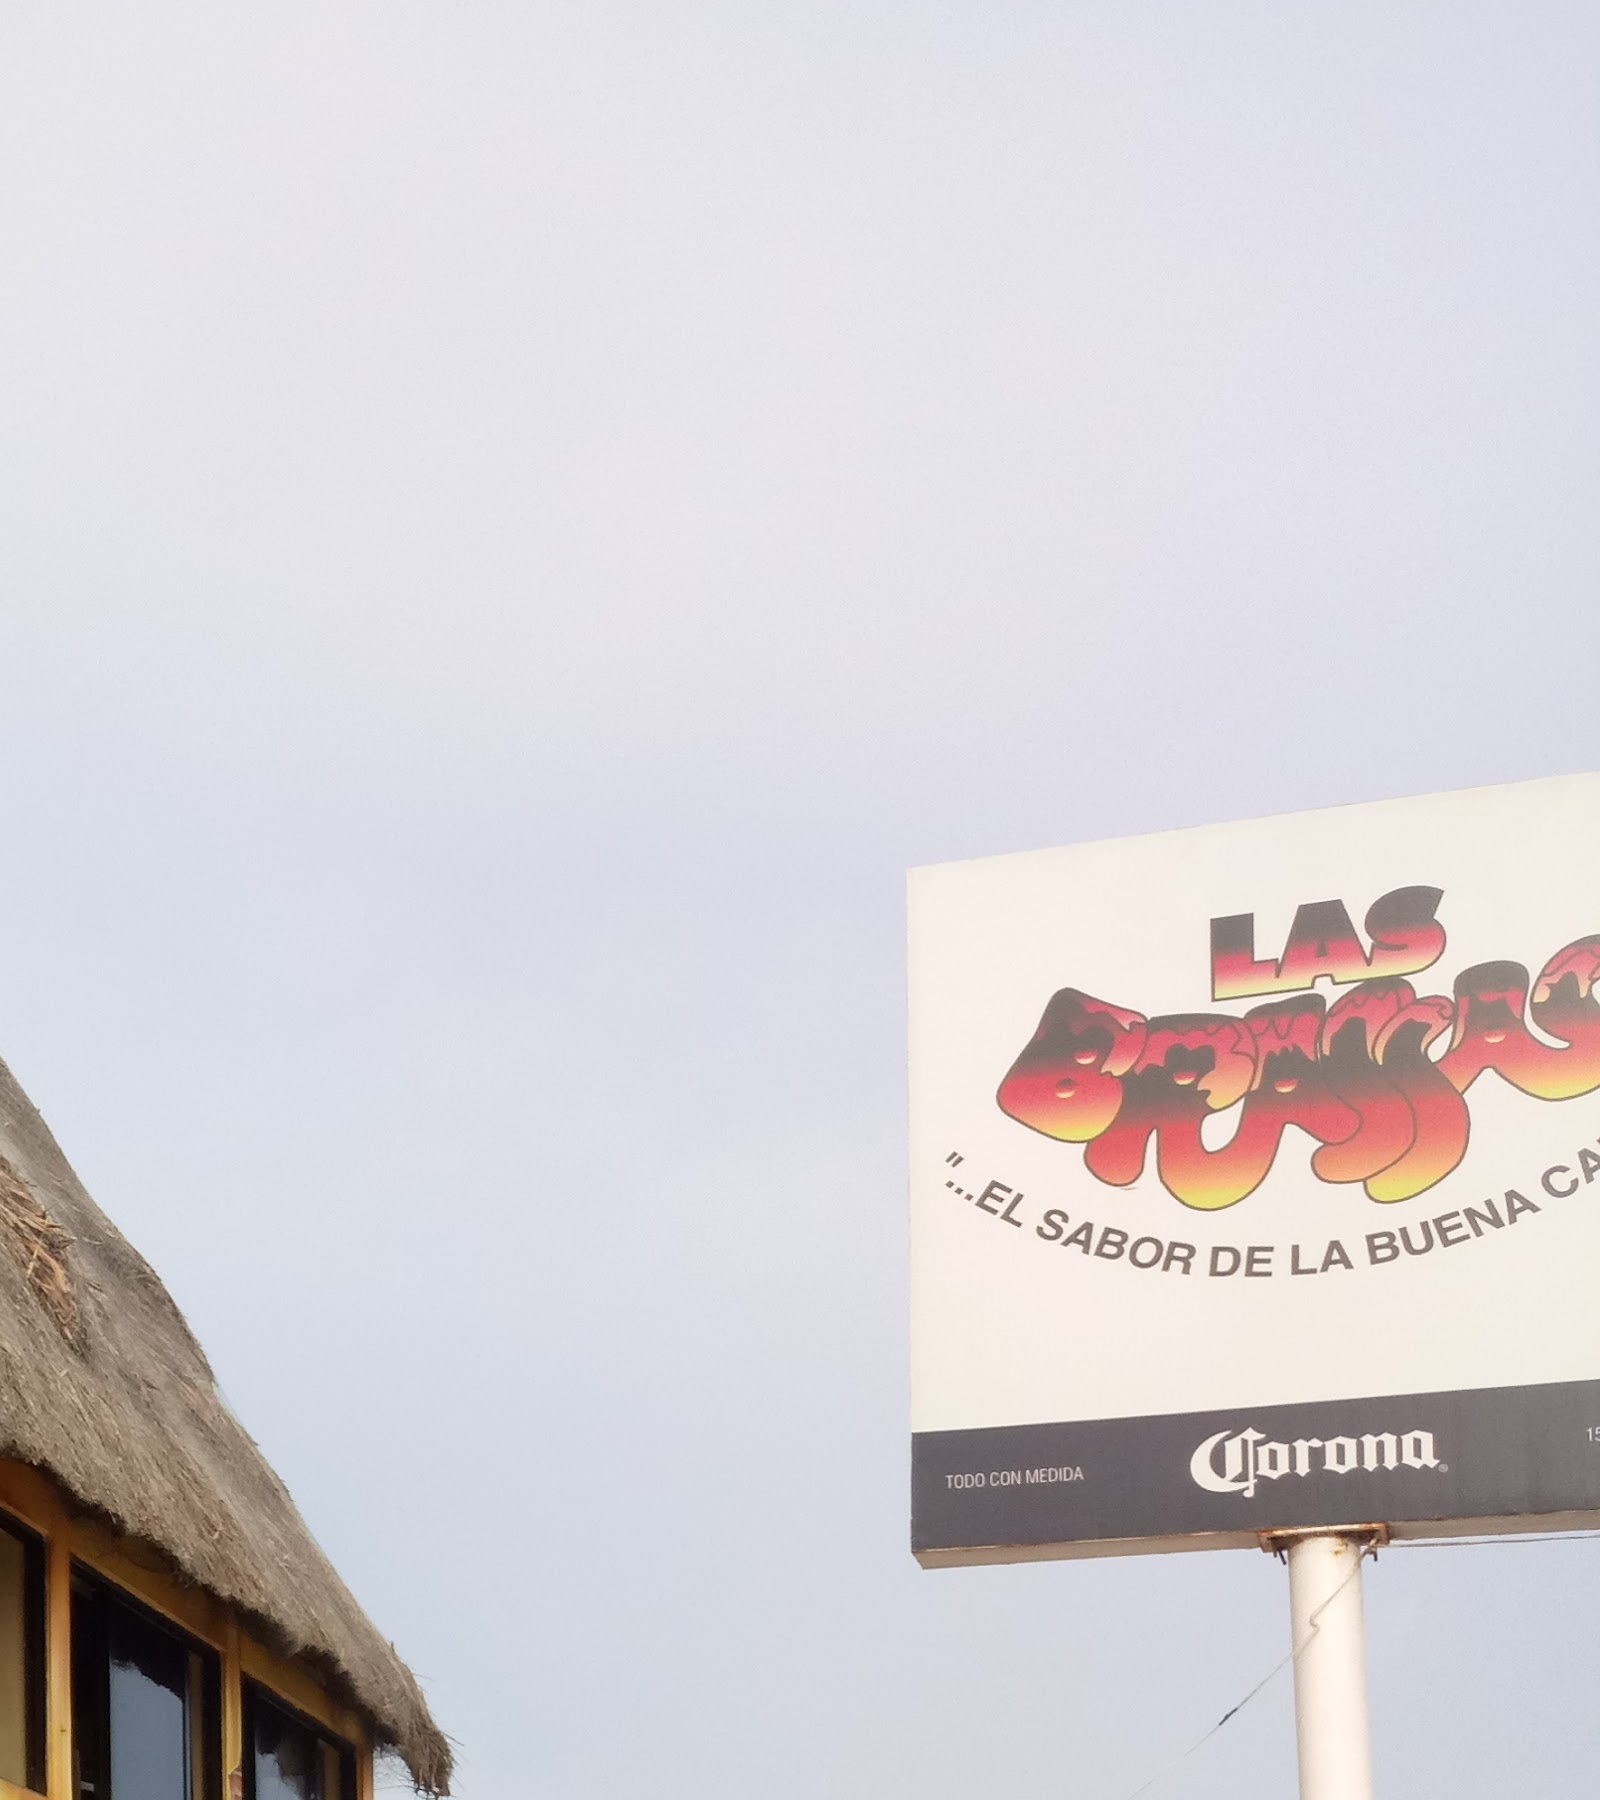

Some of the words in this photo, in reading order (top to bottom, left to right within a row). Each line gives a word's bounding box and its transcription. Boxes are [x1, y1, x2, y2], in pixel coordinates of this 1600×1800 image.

[1210, 885, 1446, 1001] LAS
[1036, 1209, 1196, 1275] SABOR
[1209, 1246, 1274, 1277] DE
[1291, 1240, 1354, 1275] LA
[1365, 1189, 1542, 1265] BUENA
[1541, 1136, 1600, 1198] CA
[945, 1473, 985, 1489] TODO
[989, 1470, 1021, 1486] CON
[1025, 1466, 1085, 1484] MEDIDA
[1190, 1426, 1441, 1498] Corona
